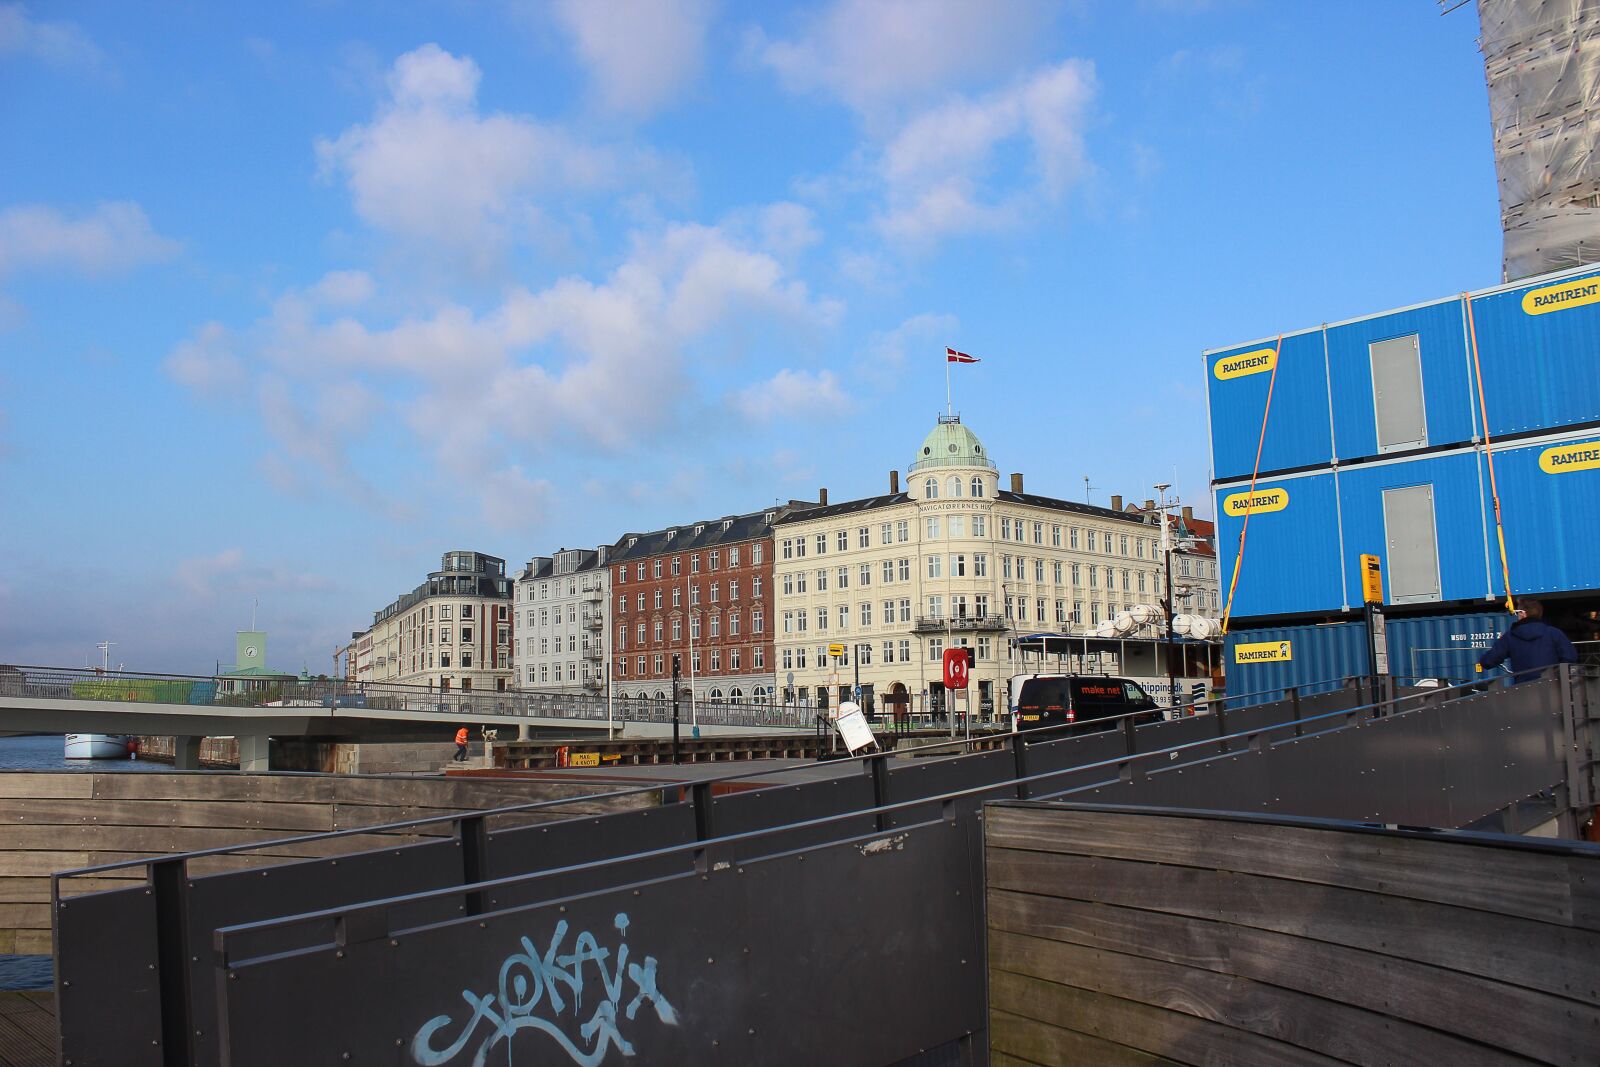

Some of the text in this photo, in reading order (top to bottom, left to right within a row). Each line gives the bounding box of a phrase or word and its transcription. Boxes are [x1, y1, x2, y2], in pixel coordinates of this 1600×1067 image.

[1534, 284, 1598, 307] RAMIRENT
[1222, 355, 1269, 373] RAMIRENT
[1238, 650, 1278, 660] RAMIRENT
